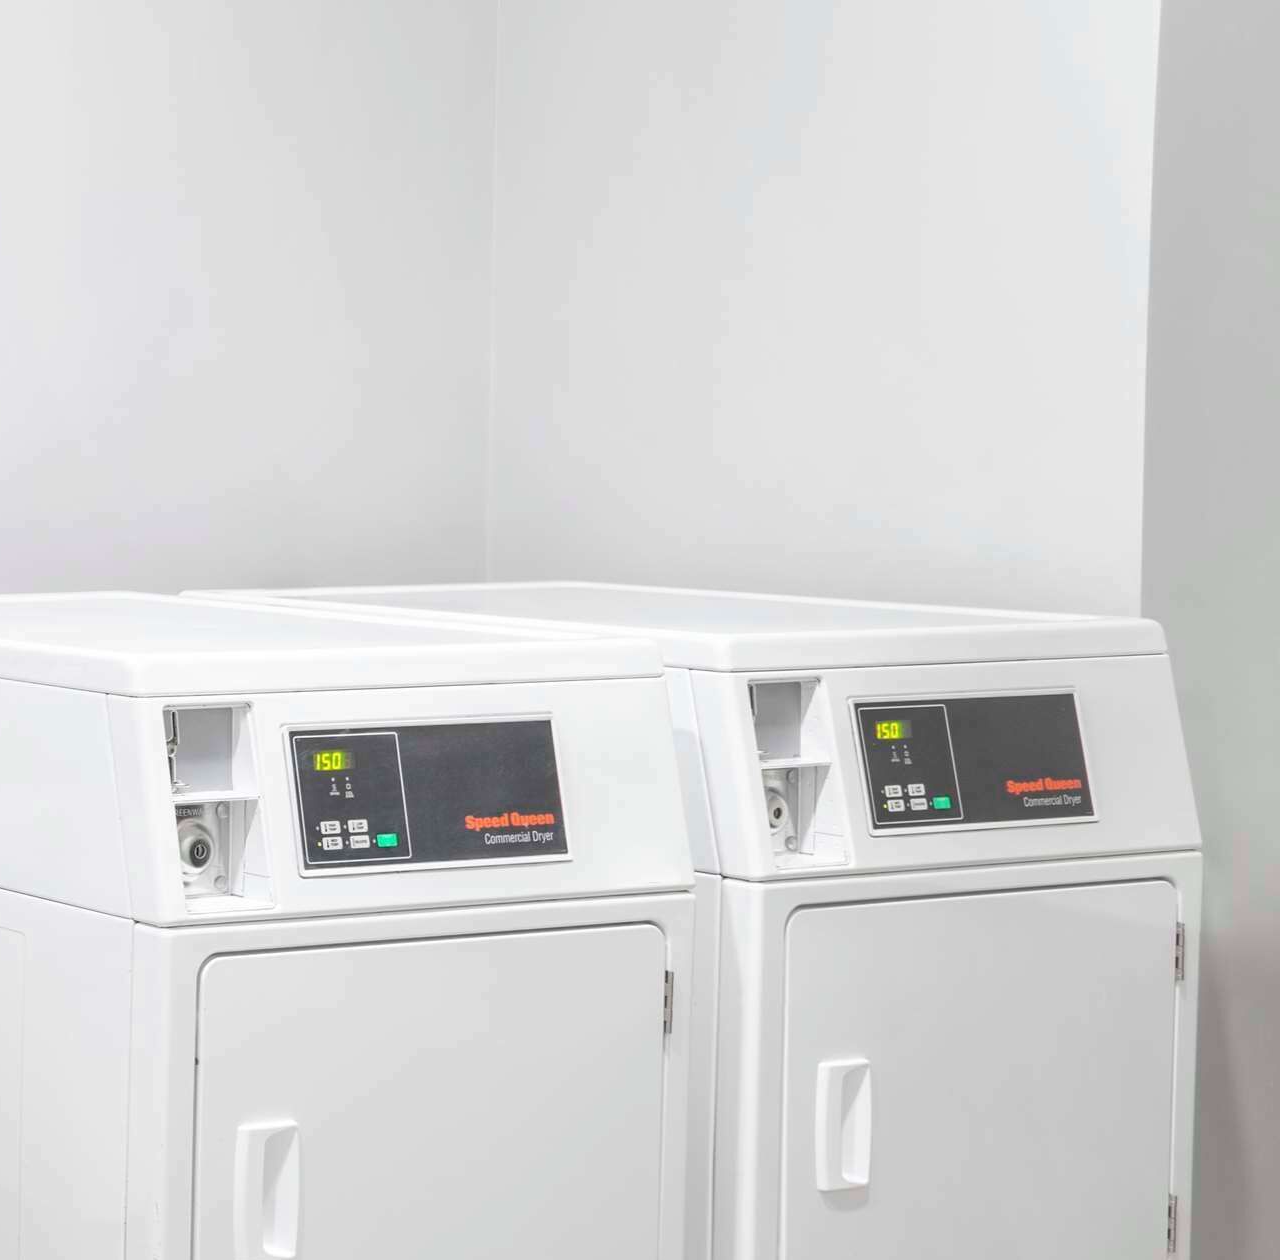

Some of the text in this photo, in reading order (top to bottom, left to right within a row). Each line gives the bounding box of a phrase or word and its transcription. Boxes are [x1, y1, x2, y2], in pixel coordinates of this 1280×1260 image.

[876, 722, 899, 739] 150
[315, 752, 342, 771] 150
[465, 812, 555, 831] Speed Queen
[484, 830, 554, 845] Commercial Dryer
